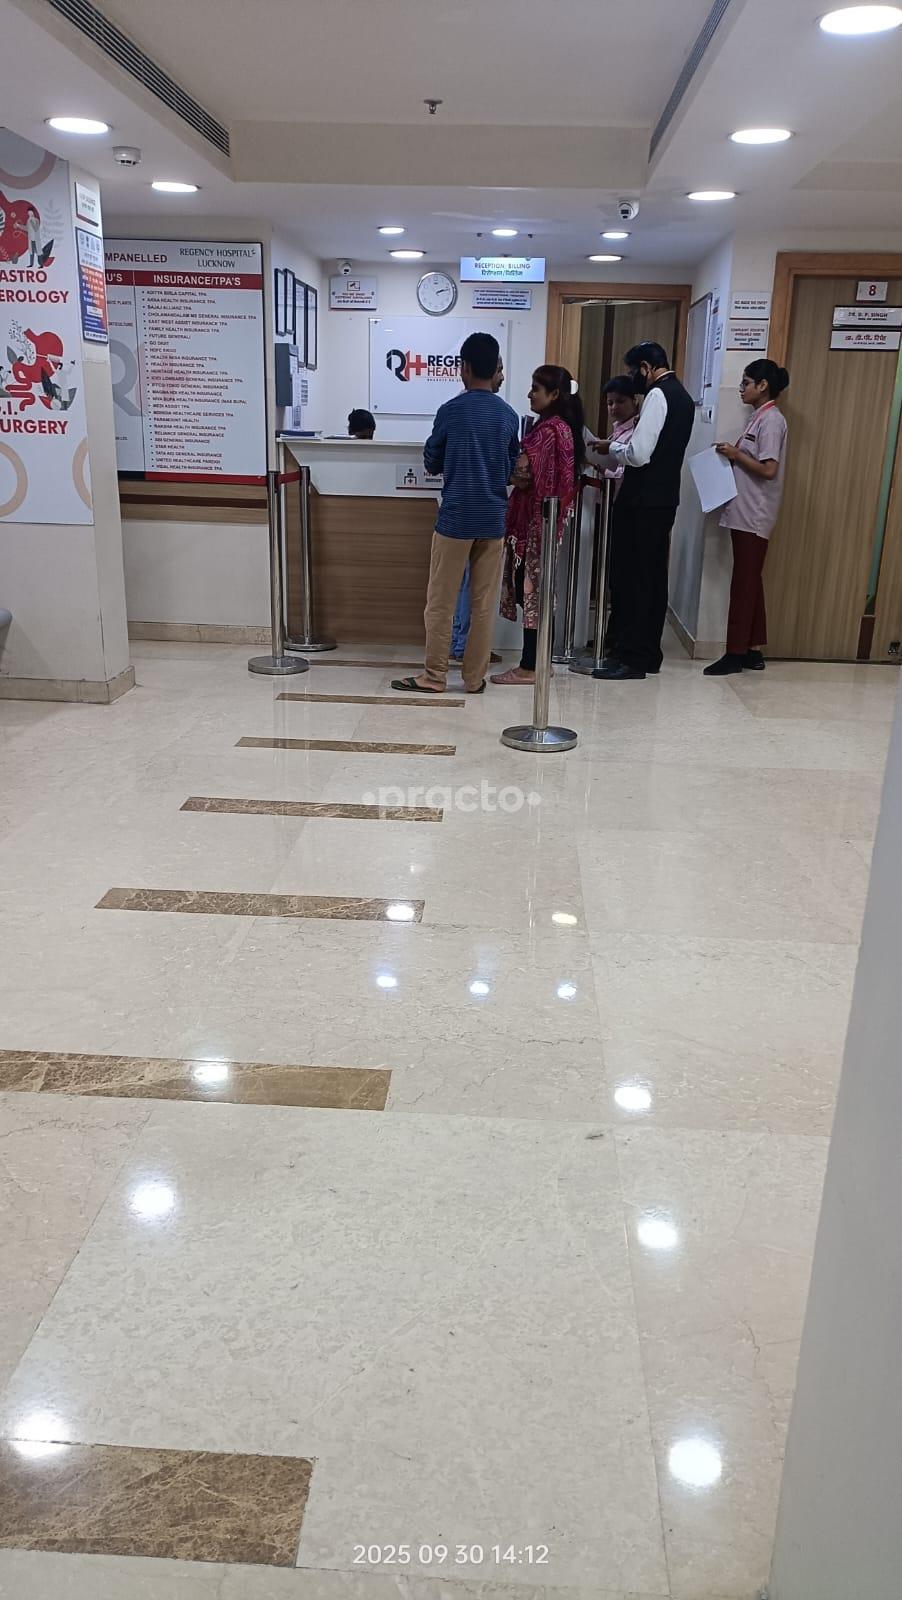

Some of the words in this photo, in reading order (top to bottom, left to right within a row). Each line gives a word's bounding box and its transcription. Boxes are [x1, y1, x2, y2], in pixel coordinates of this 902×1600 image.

[104, 252, 168, 263] MPANELLED
[180, 248, 214, 256] REGENCY
[198, 260, 236, 268] LUCKNOW
[0, 270, 47, 282] ASTRO
[153, 274, 241, 286] INSURANCE/TPA'S
[869, 284, 876, 296] 8
[428, 354, 462, 368] REGE
[0, 418, 68, 434] URGERY
